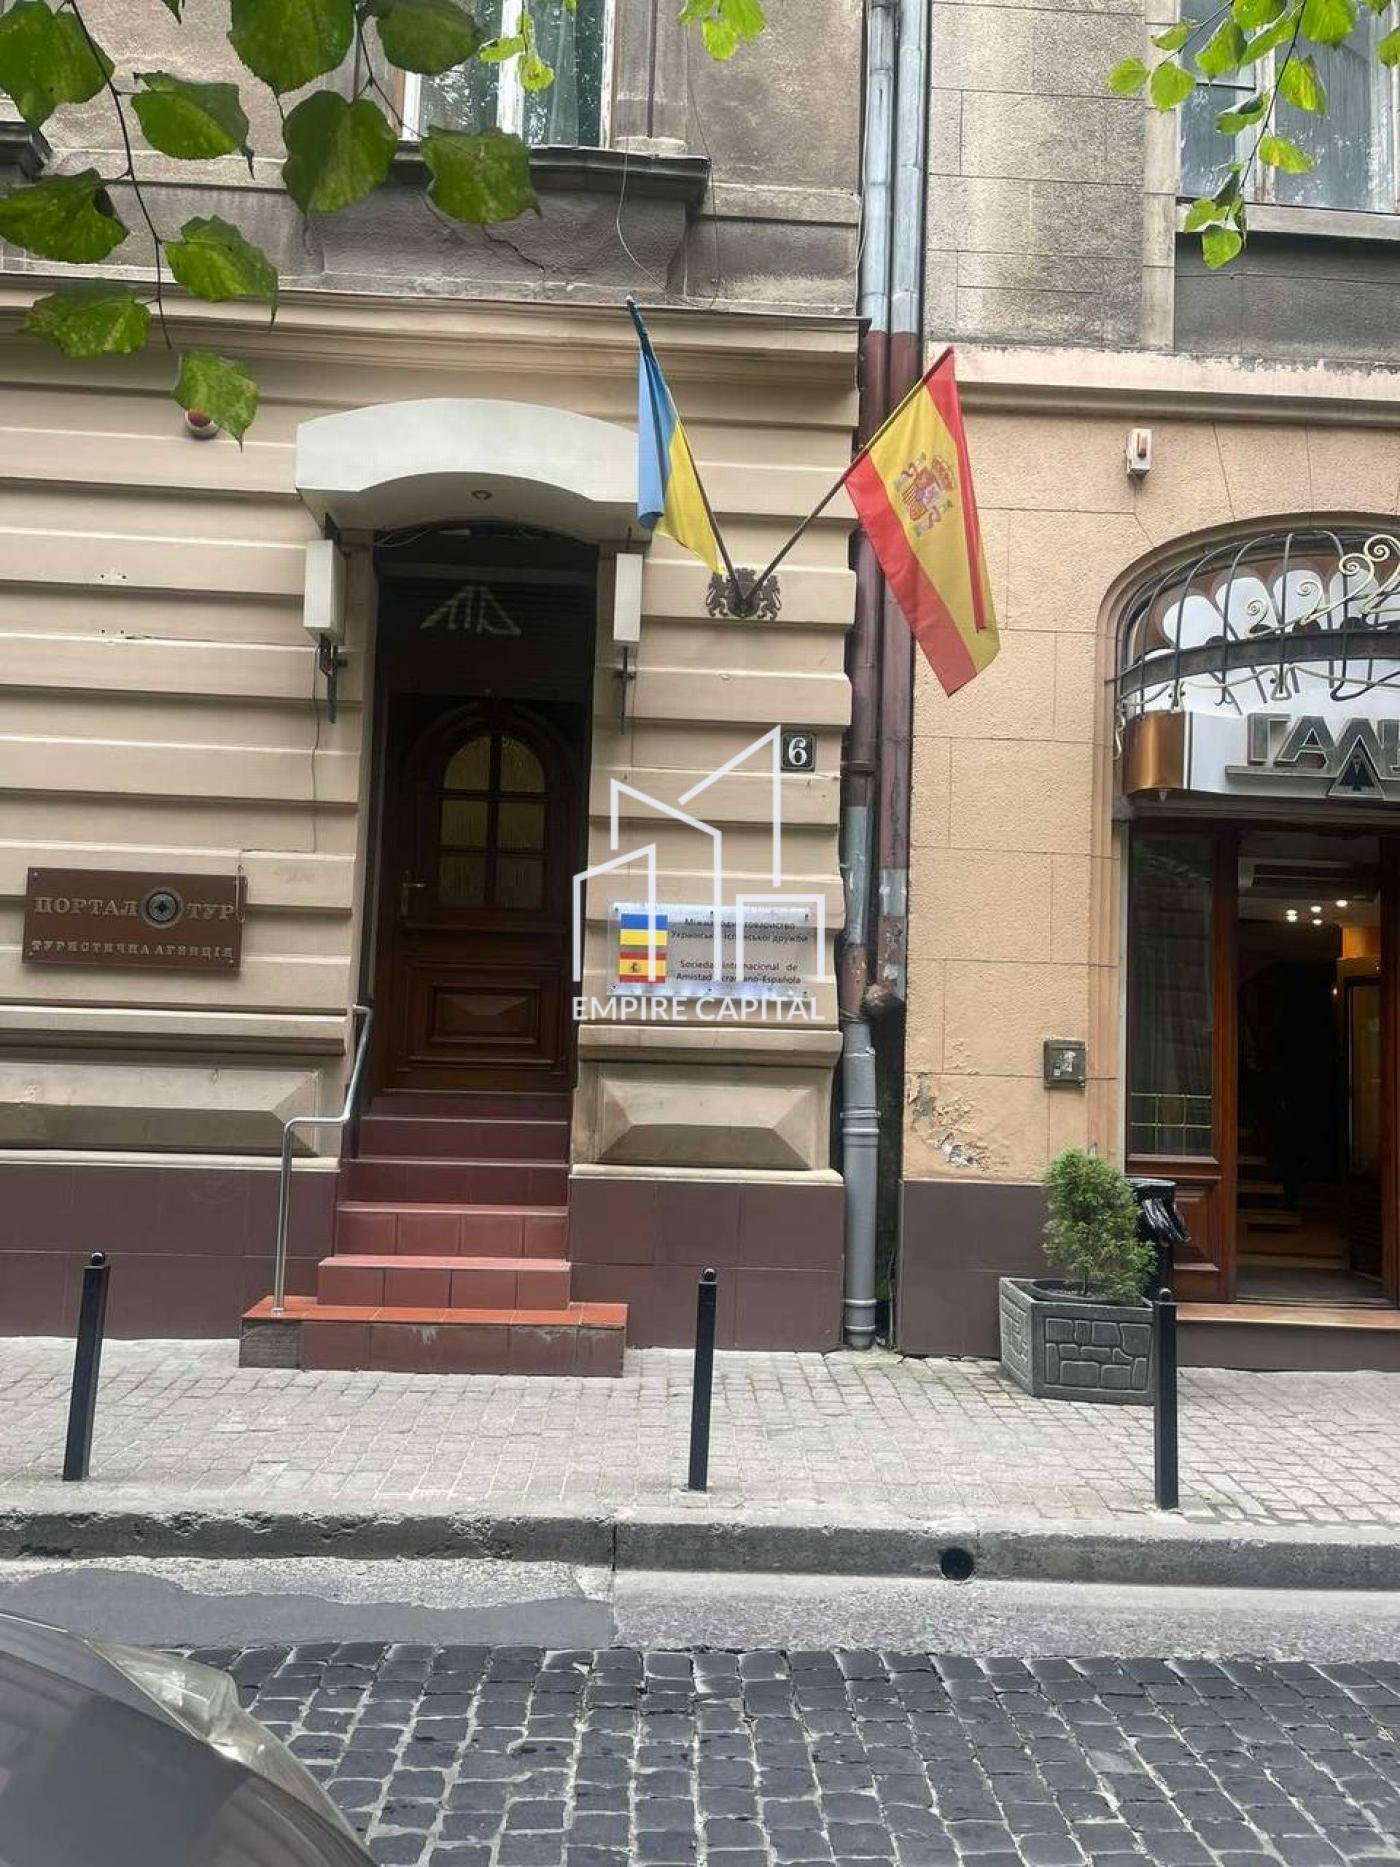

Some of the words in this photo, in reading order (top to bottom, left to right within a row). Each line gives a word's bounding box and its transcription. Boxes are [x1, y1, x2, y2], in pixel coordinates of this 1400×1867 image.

[788, 736, 808, 766] 6
[33, 896, 138, 917] ПОРТАЛ
[186, 902, 234, 921] ТУР
[680, 959, 719, 969] Socieda
